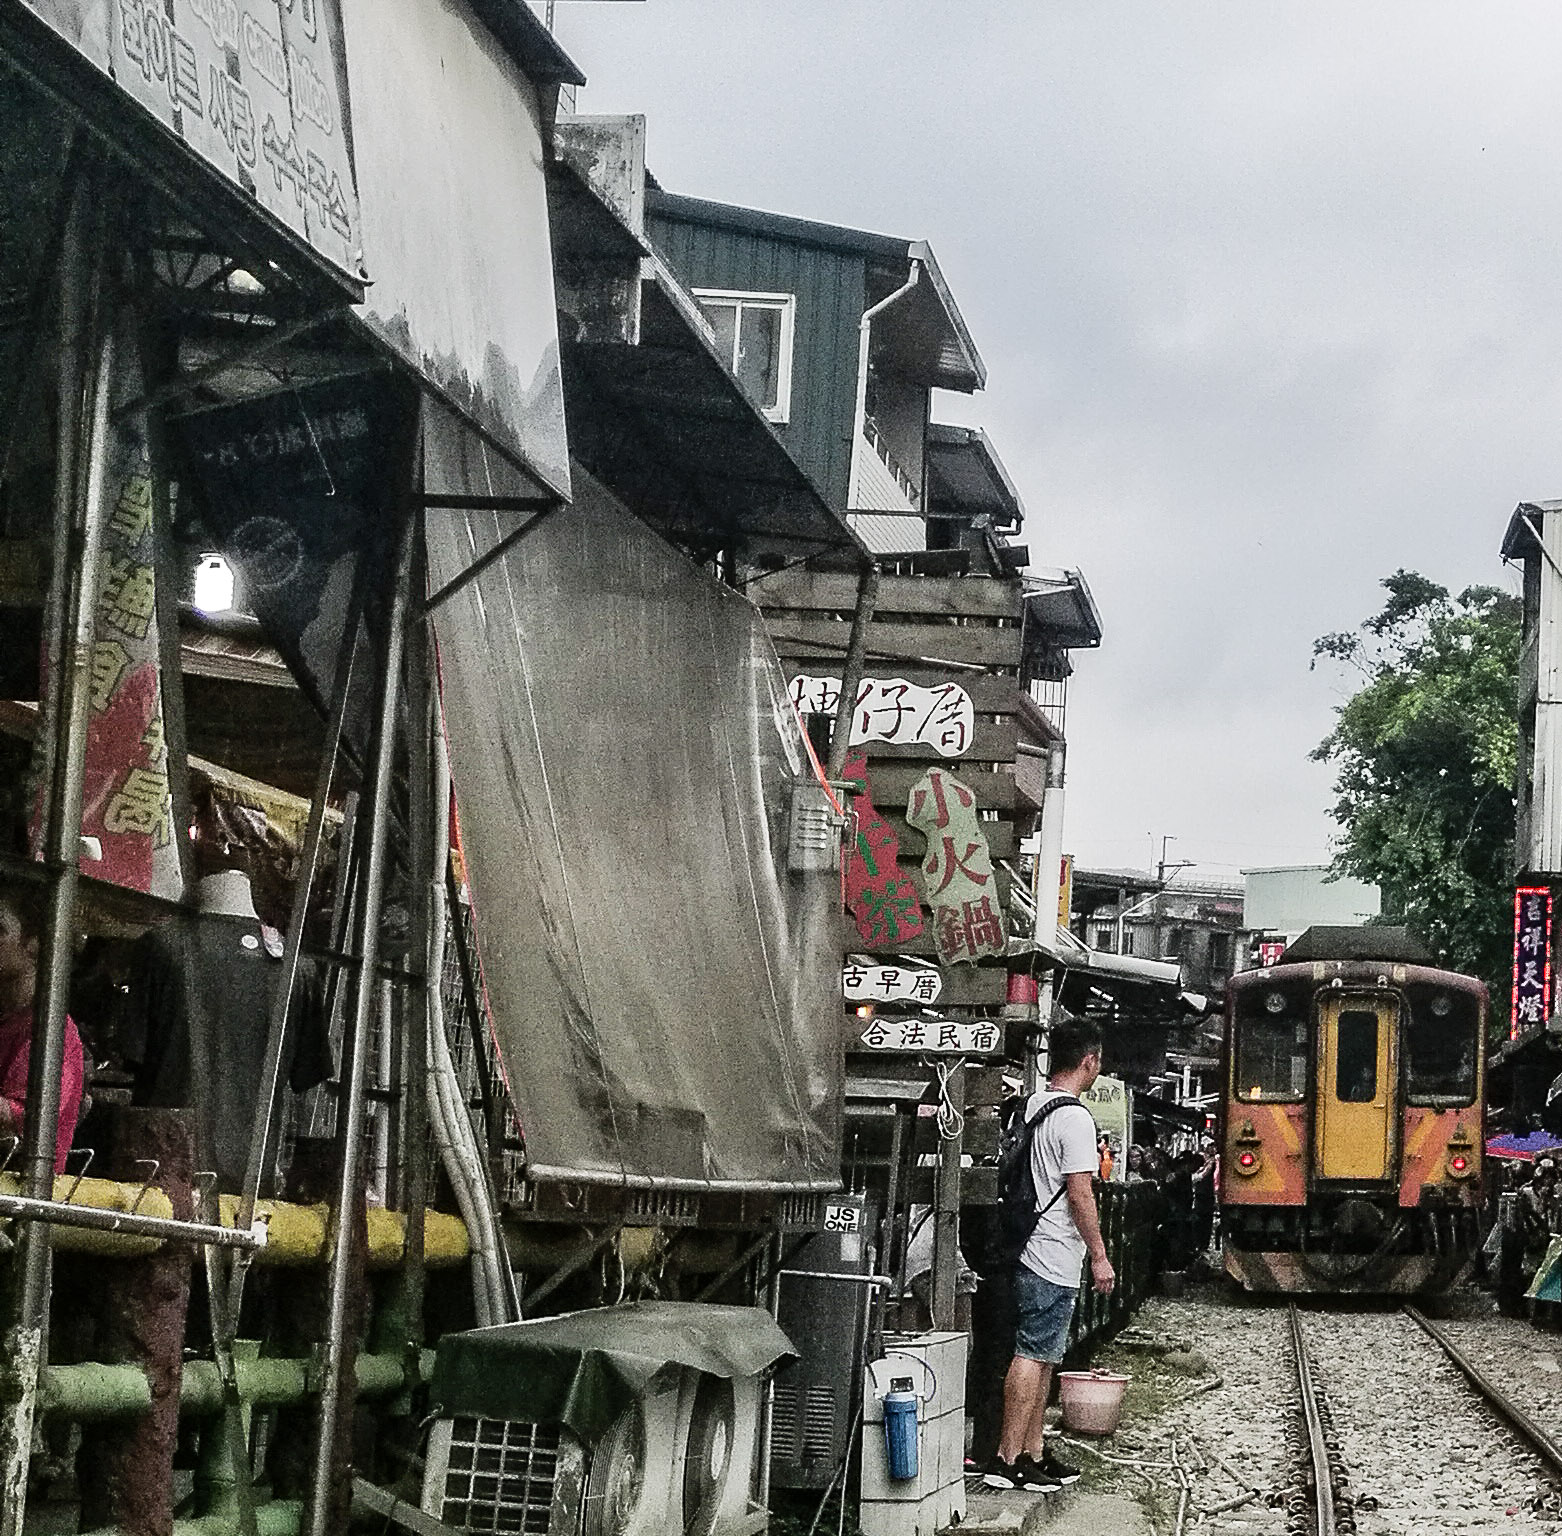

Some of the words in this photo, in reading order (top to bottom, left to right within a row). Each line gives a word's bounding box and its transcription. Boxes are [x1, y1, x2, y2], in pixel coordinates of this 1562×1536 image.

[243, 12, 288, 97] cane
[289, 40, 333, 134] juice
[210, 59, 258, 168] 사탕
[913, 772, 1002, 958] 小火鍋
[844, 966, 937, 1001] 古早厝
[1519, 895, 1544, 1022] 吉祥天燈
[864, 1021, 998, 1050] 合法民宿
[826, 1221, 856, 1231] ONE
[831, 1208, 855, 1221] JS
